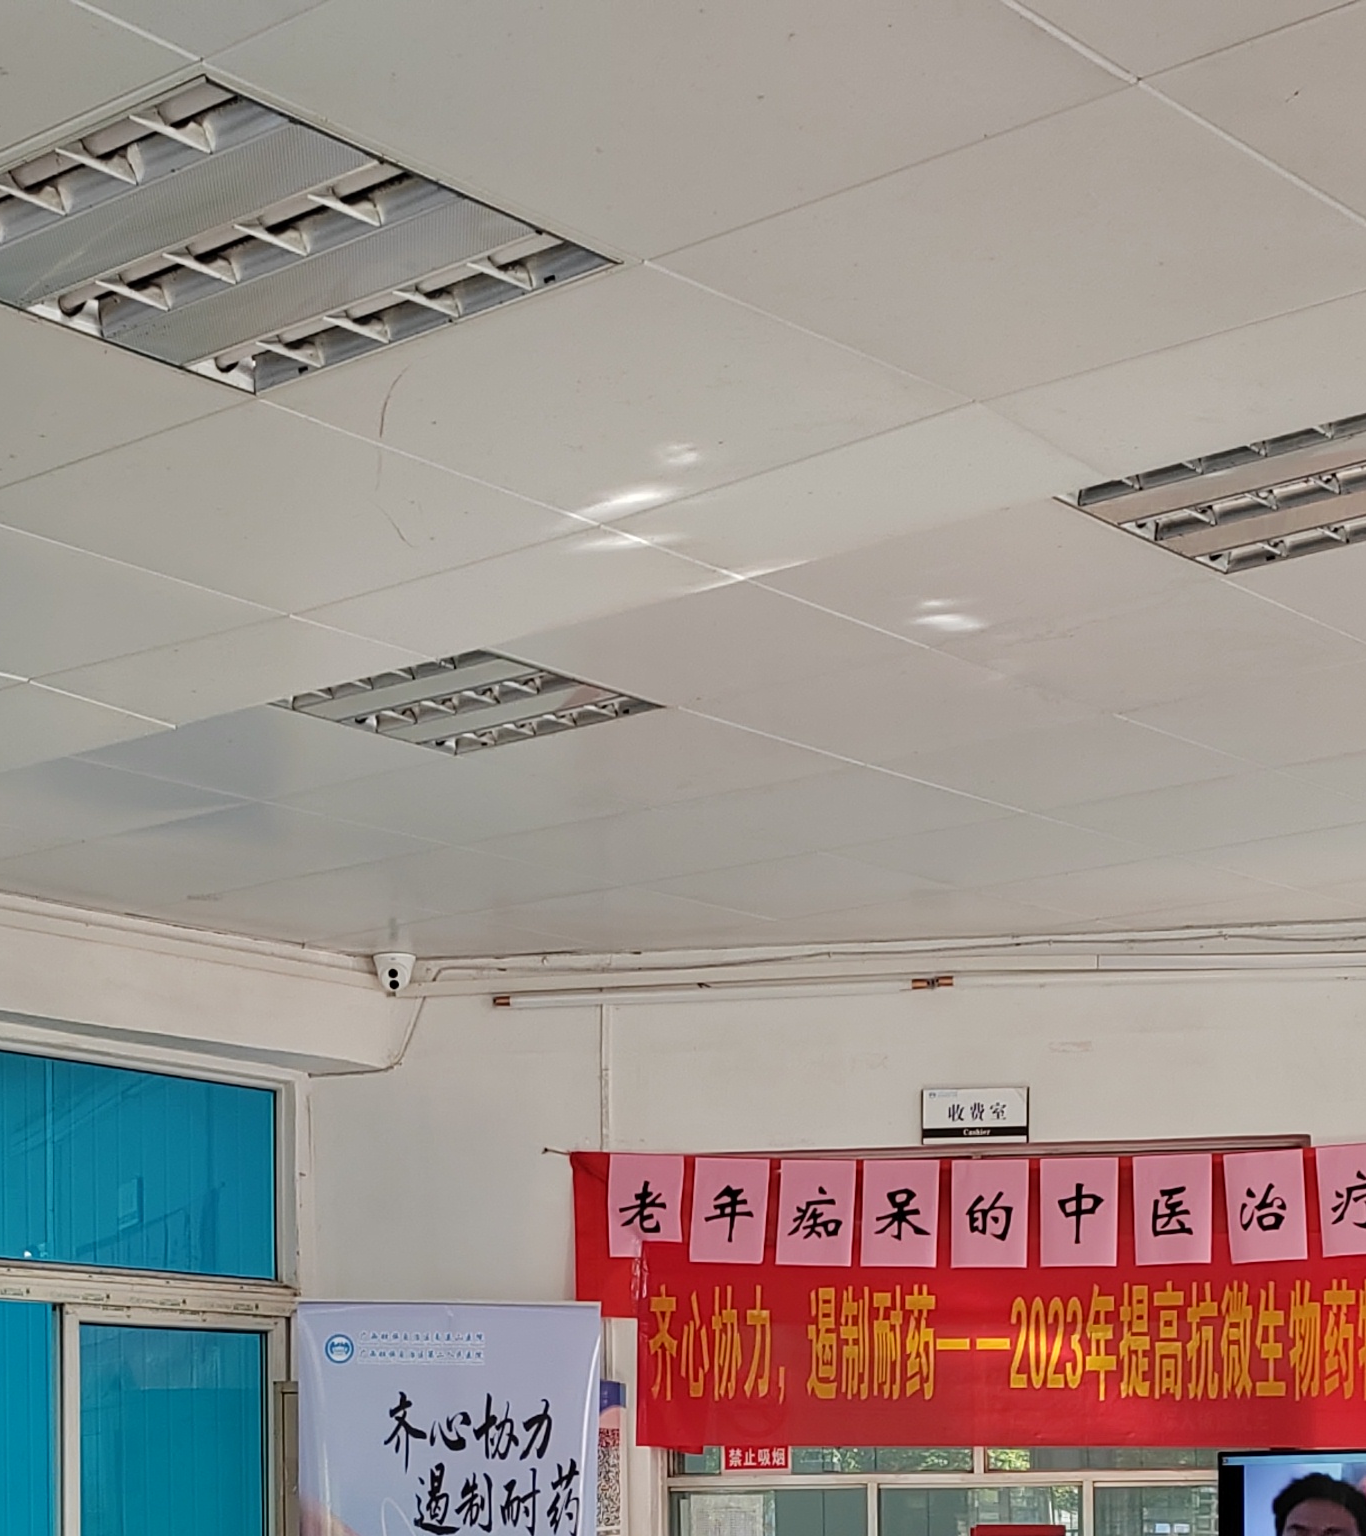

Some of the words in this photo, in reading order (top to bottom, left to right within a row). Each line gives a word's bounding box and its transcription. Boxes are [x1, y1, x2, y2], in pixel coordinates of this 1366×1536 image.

[948, 1102, 1007, 1121] 收费室
[963, 1128, 991, 1137] Cashier
[384, 1391, 552, 1473] 齐心协力
[729, 1447, 786, 1467] 禁止吸烟
